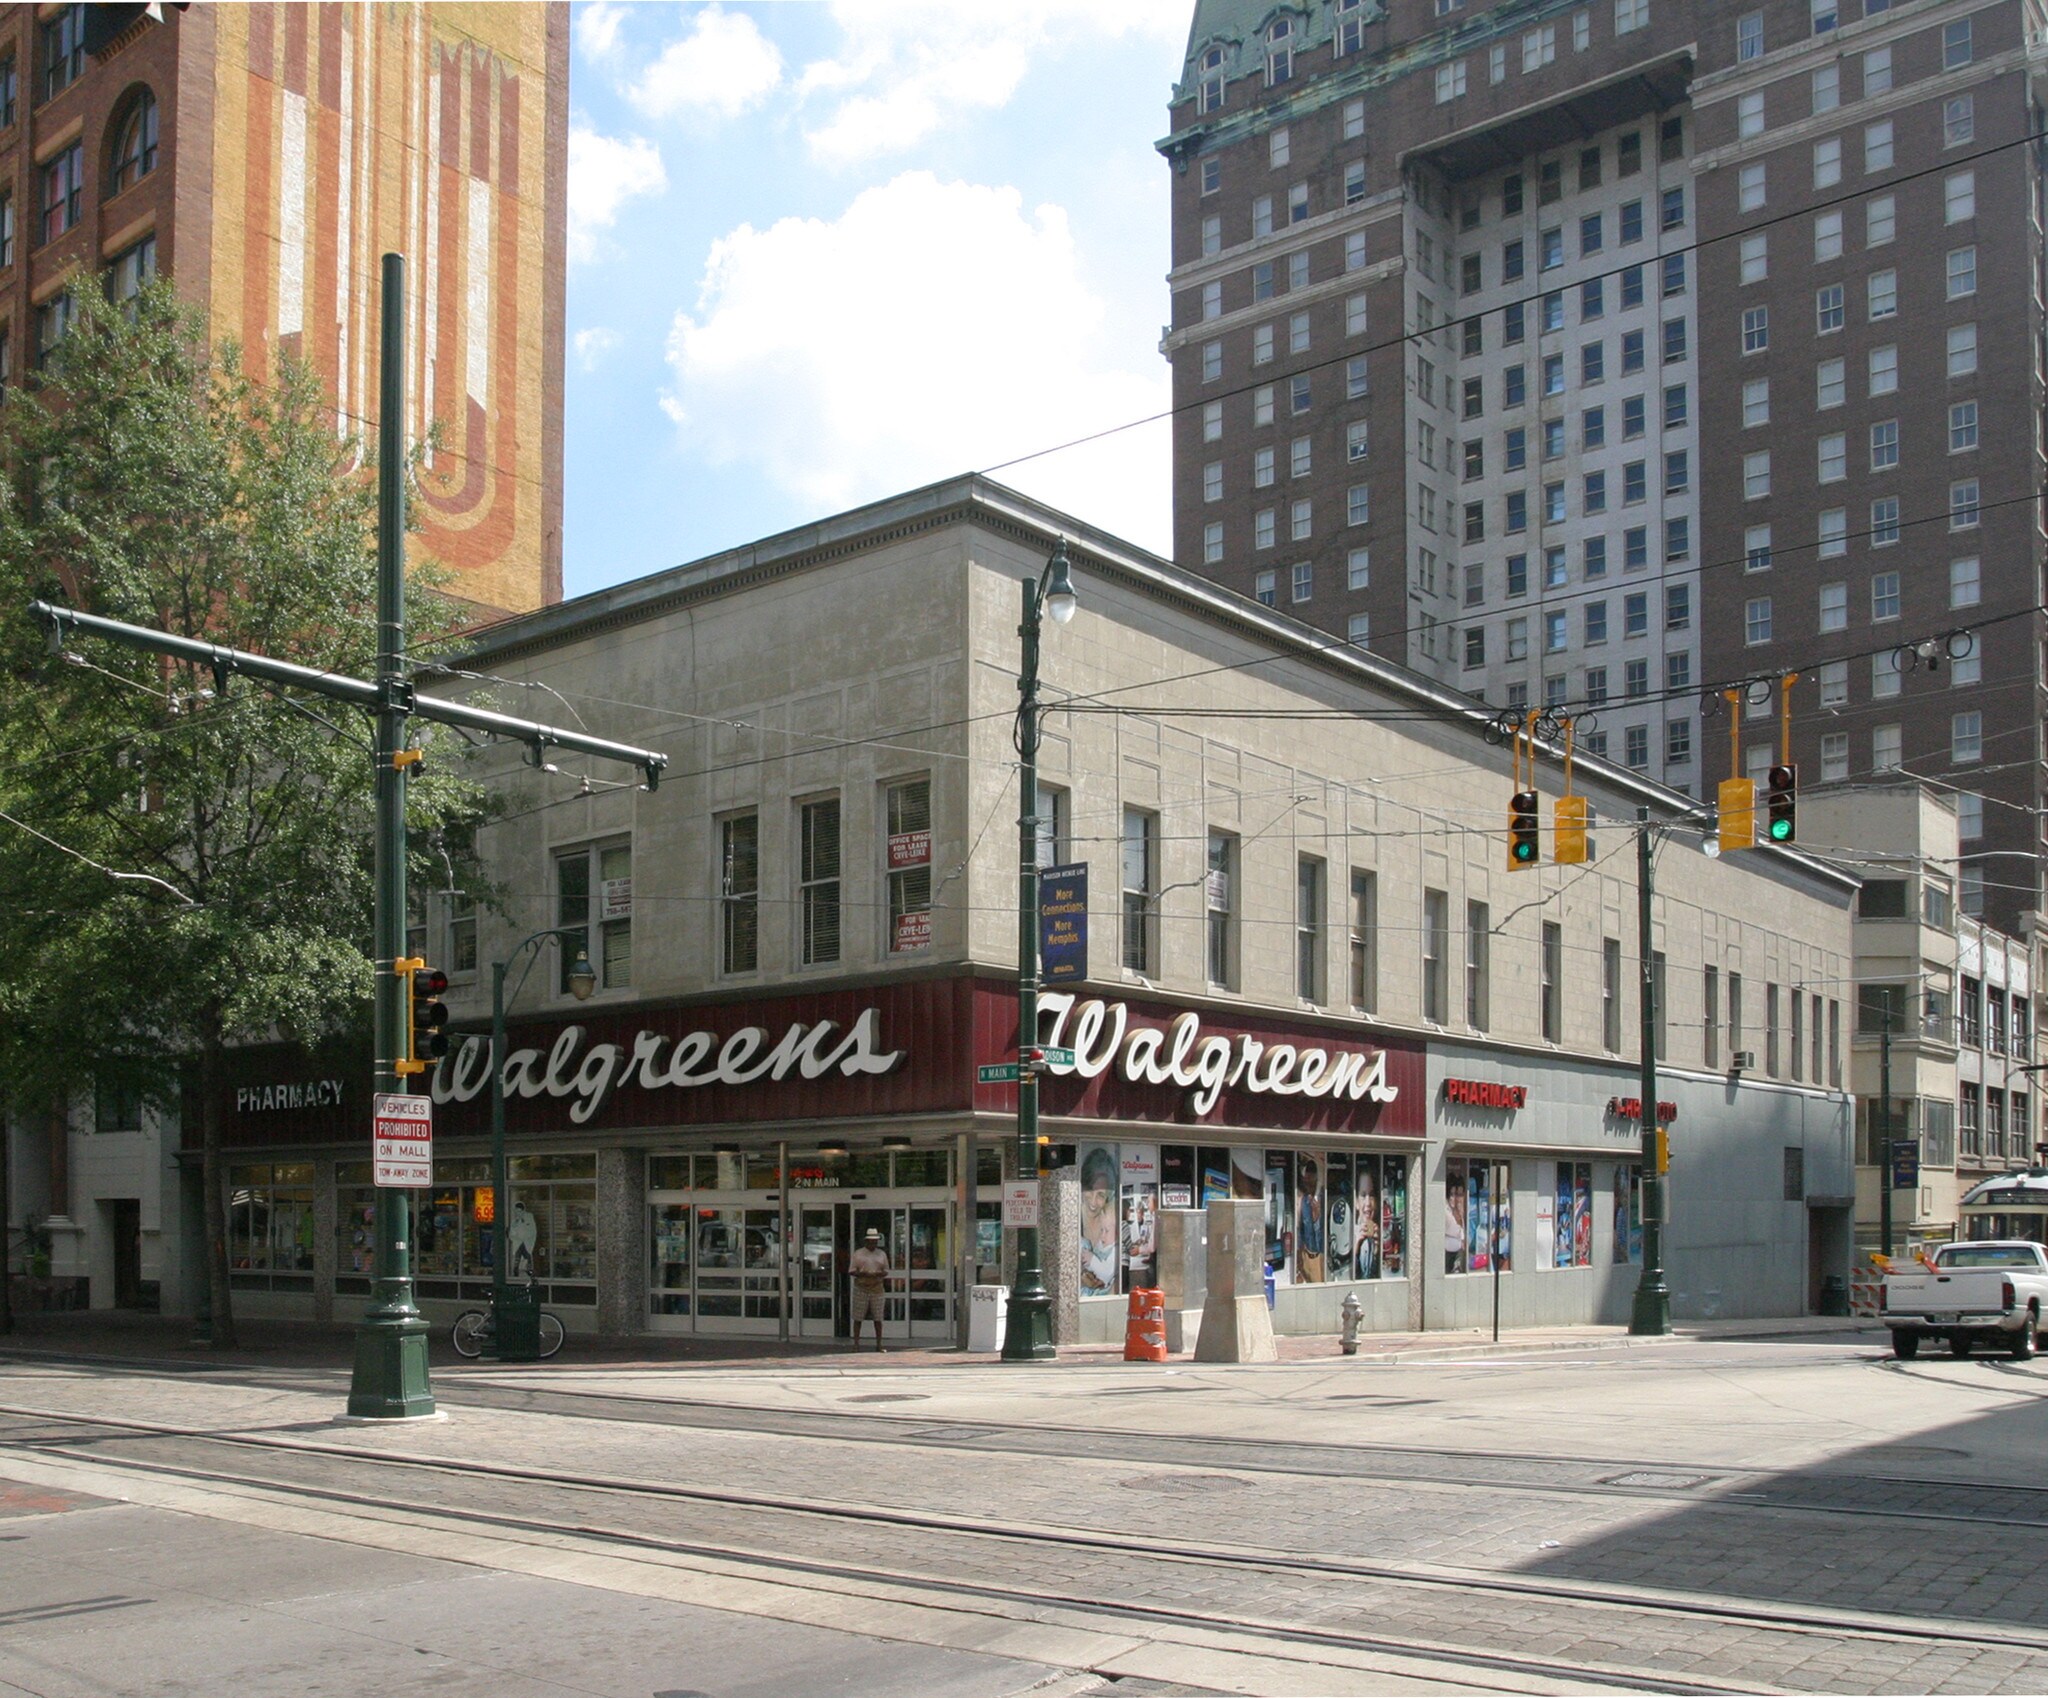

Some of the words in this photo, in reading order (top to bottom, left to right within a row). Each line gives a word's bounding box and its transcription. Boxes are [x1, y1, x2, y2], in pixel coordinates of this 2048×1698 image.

[908, 841, 928, 850] LEASE
[1056, 889, 1073, 900] More
[1055, 921, 1072, 931] More
[1037, 993, 1400, 1116] Walgreens
[1042, 1050, 1065, 1063] DISON
[431, 1008, 903, 1124] Walgreens
[981, 1069, 985, 1077] N
[988, 1067, 1008, 1079] MAIN
[237, 1080, 344, 1112] PHARMACY
[1446, 1079, 1527, 1109] PHARMACY
[381, 1102, 425, 1115] VEHICLES
[378, 1122, 427, 1138] PROHIBITED
[380, 1145, 392, 1155] ON
[399, 1146, 426, 1157] MALL
[1122, 1161, 1154, 1171] Walgreens
[379, 1167, 409, 1178] TOW-AWAY
[412, 1169, 428, 1179] ZONE
[795, 1178, 802, 1188] 2
[803, 1178, 811, 1187] N
[814, 1177, 839, 1187] MAIN
